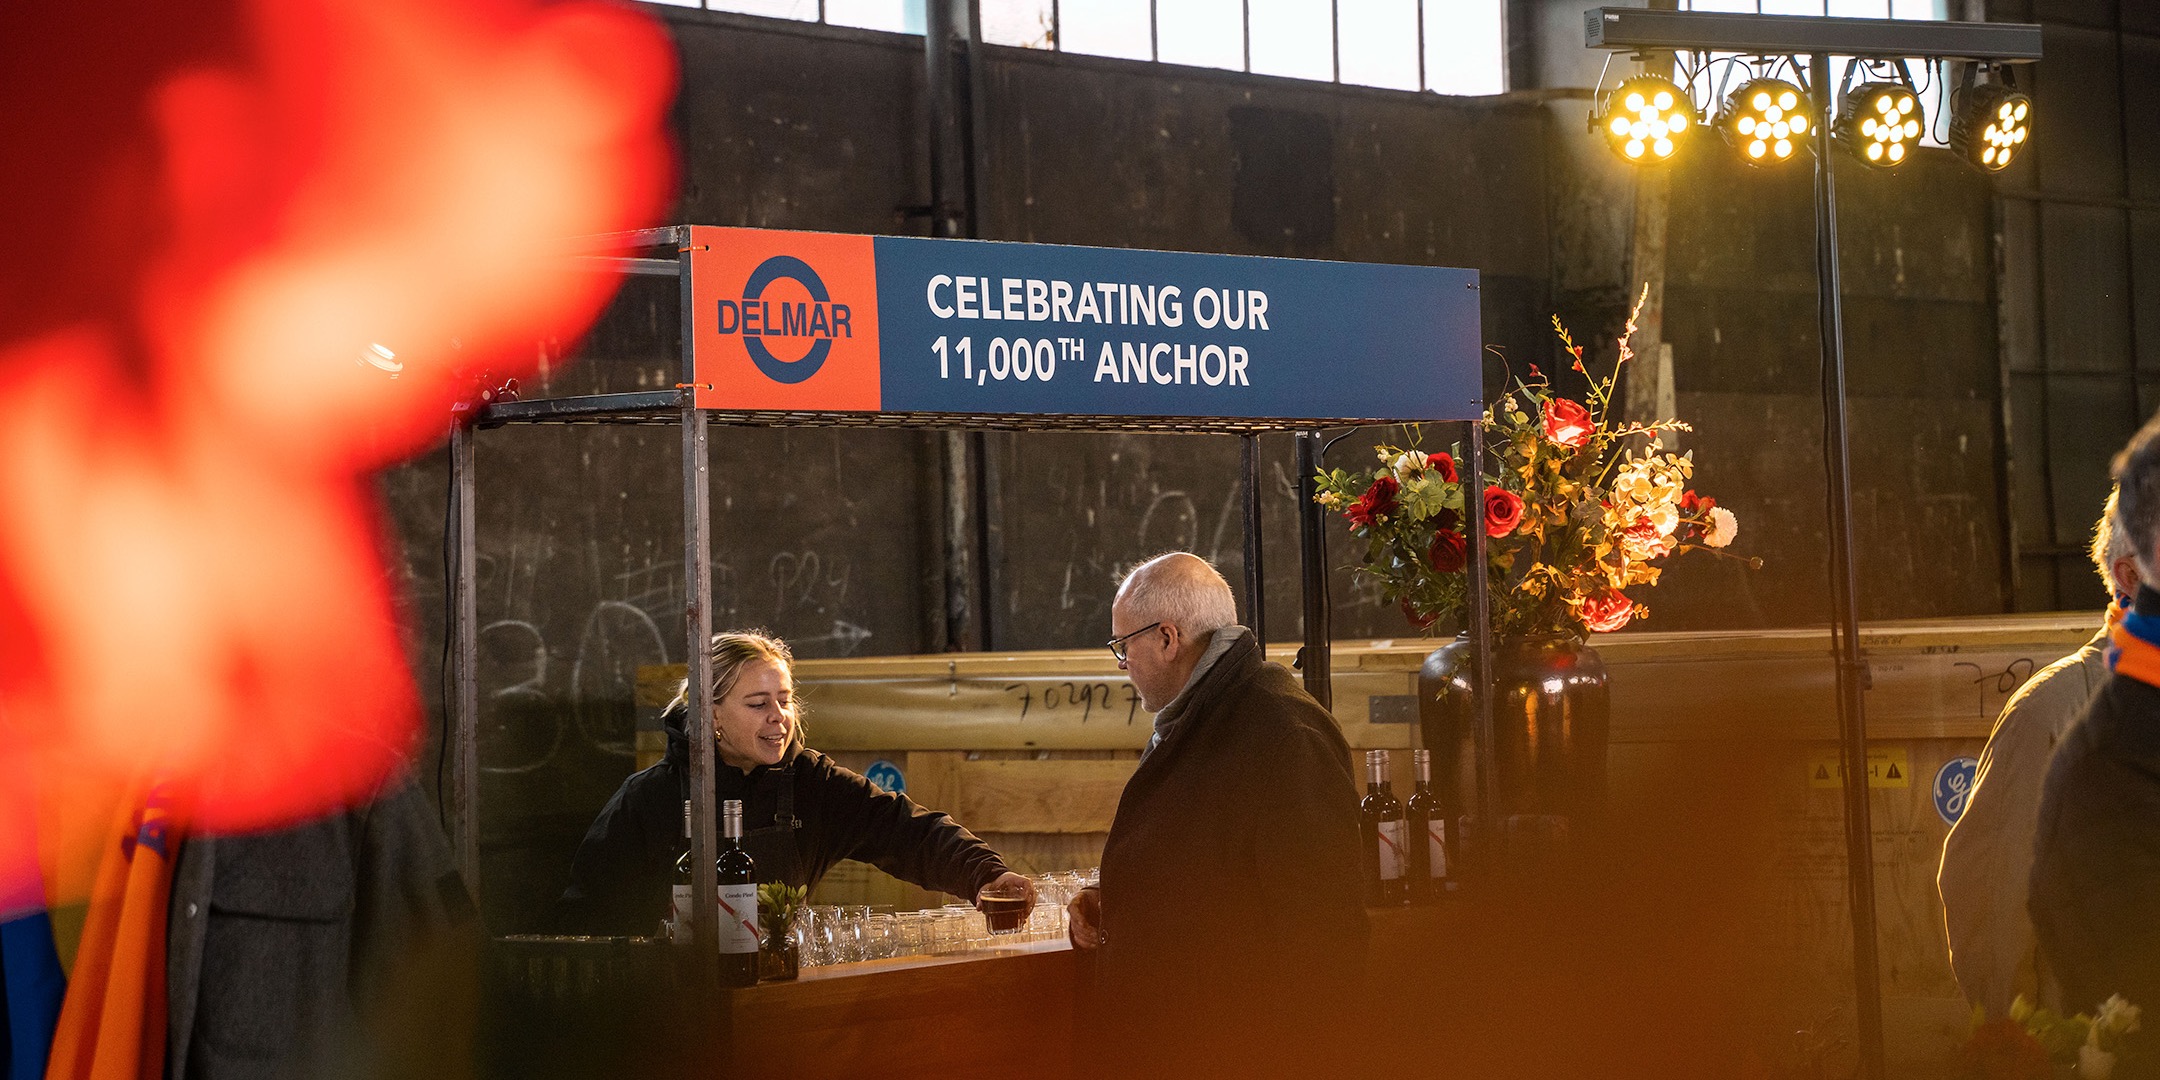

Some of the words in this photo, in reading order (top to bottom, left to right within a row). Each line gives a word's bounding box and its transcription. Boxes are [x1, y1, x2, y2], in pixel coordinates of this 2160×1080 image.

[718, 299, 852, 338] DELMAR
[927, 274, 1183, 327] CELEBRATING
[1193, 287, 1270, 331] OUR
[1094, 341, 1250, 387] ANCHOR
